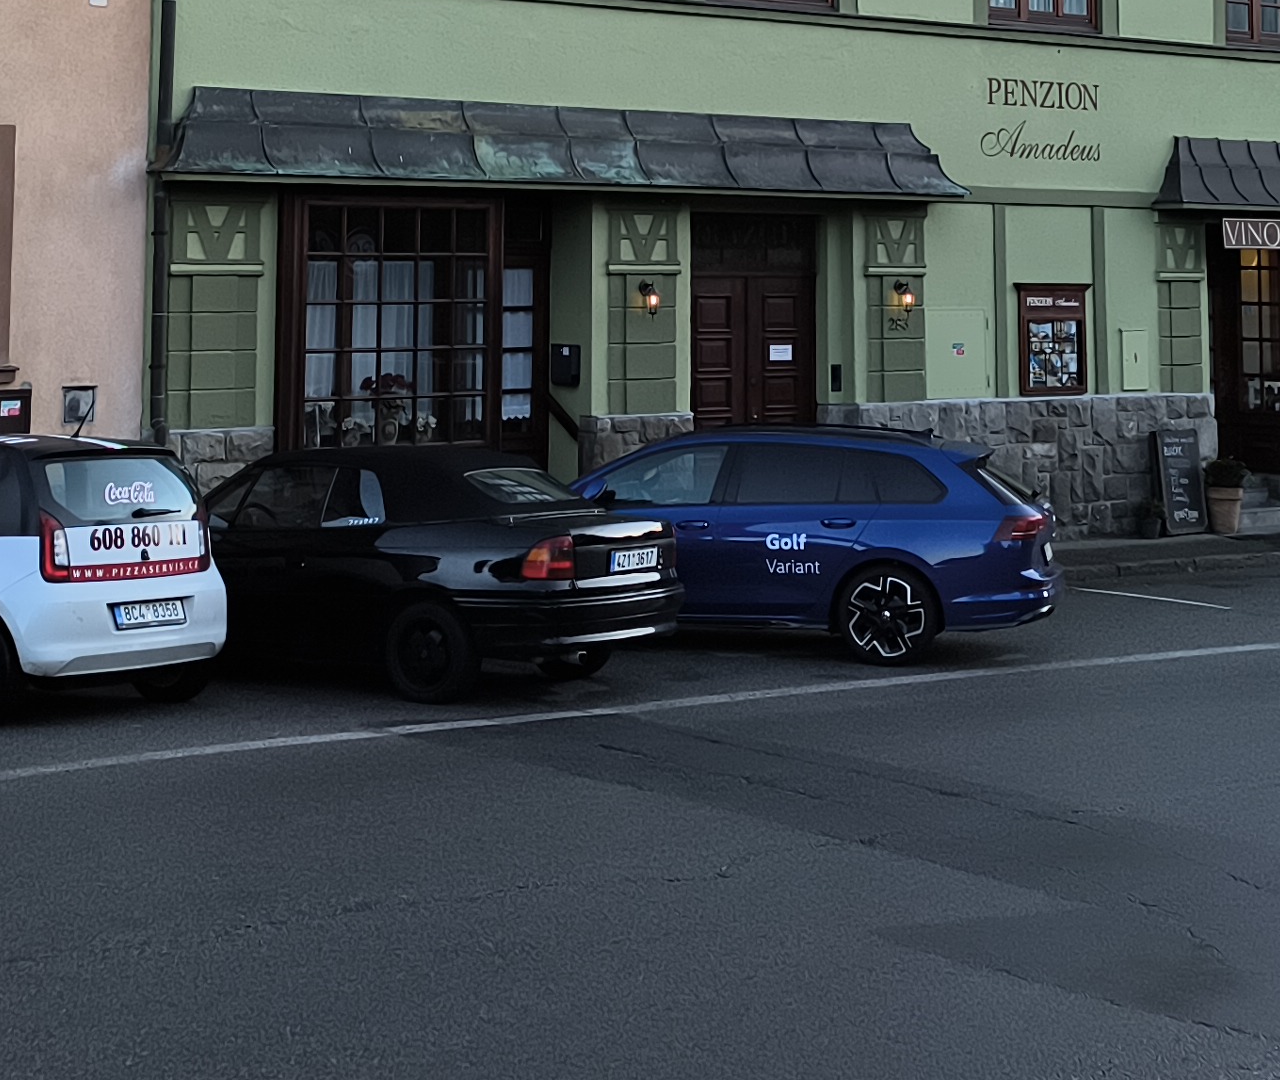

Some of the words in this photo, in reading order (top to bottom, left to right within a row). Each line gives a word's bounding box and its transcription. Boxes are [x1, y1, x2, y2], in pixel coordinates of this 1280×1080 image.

[986, 77, 1100, 111] PENZION
[980, 120, 1100, 161] Amadeus
[89, 526, 125, 551] 608
[131, 524, 161, 548] 860
[168, 523, 187, 546] 111
[765, 533, 807, 550] Golf
[765, 558, 820, 574] Variant
[123, 604, 146, 621] 8C4
